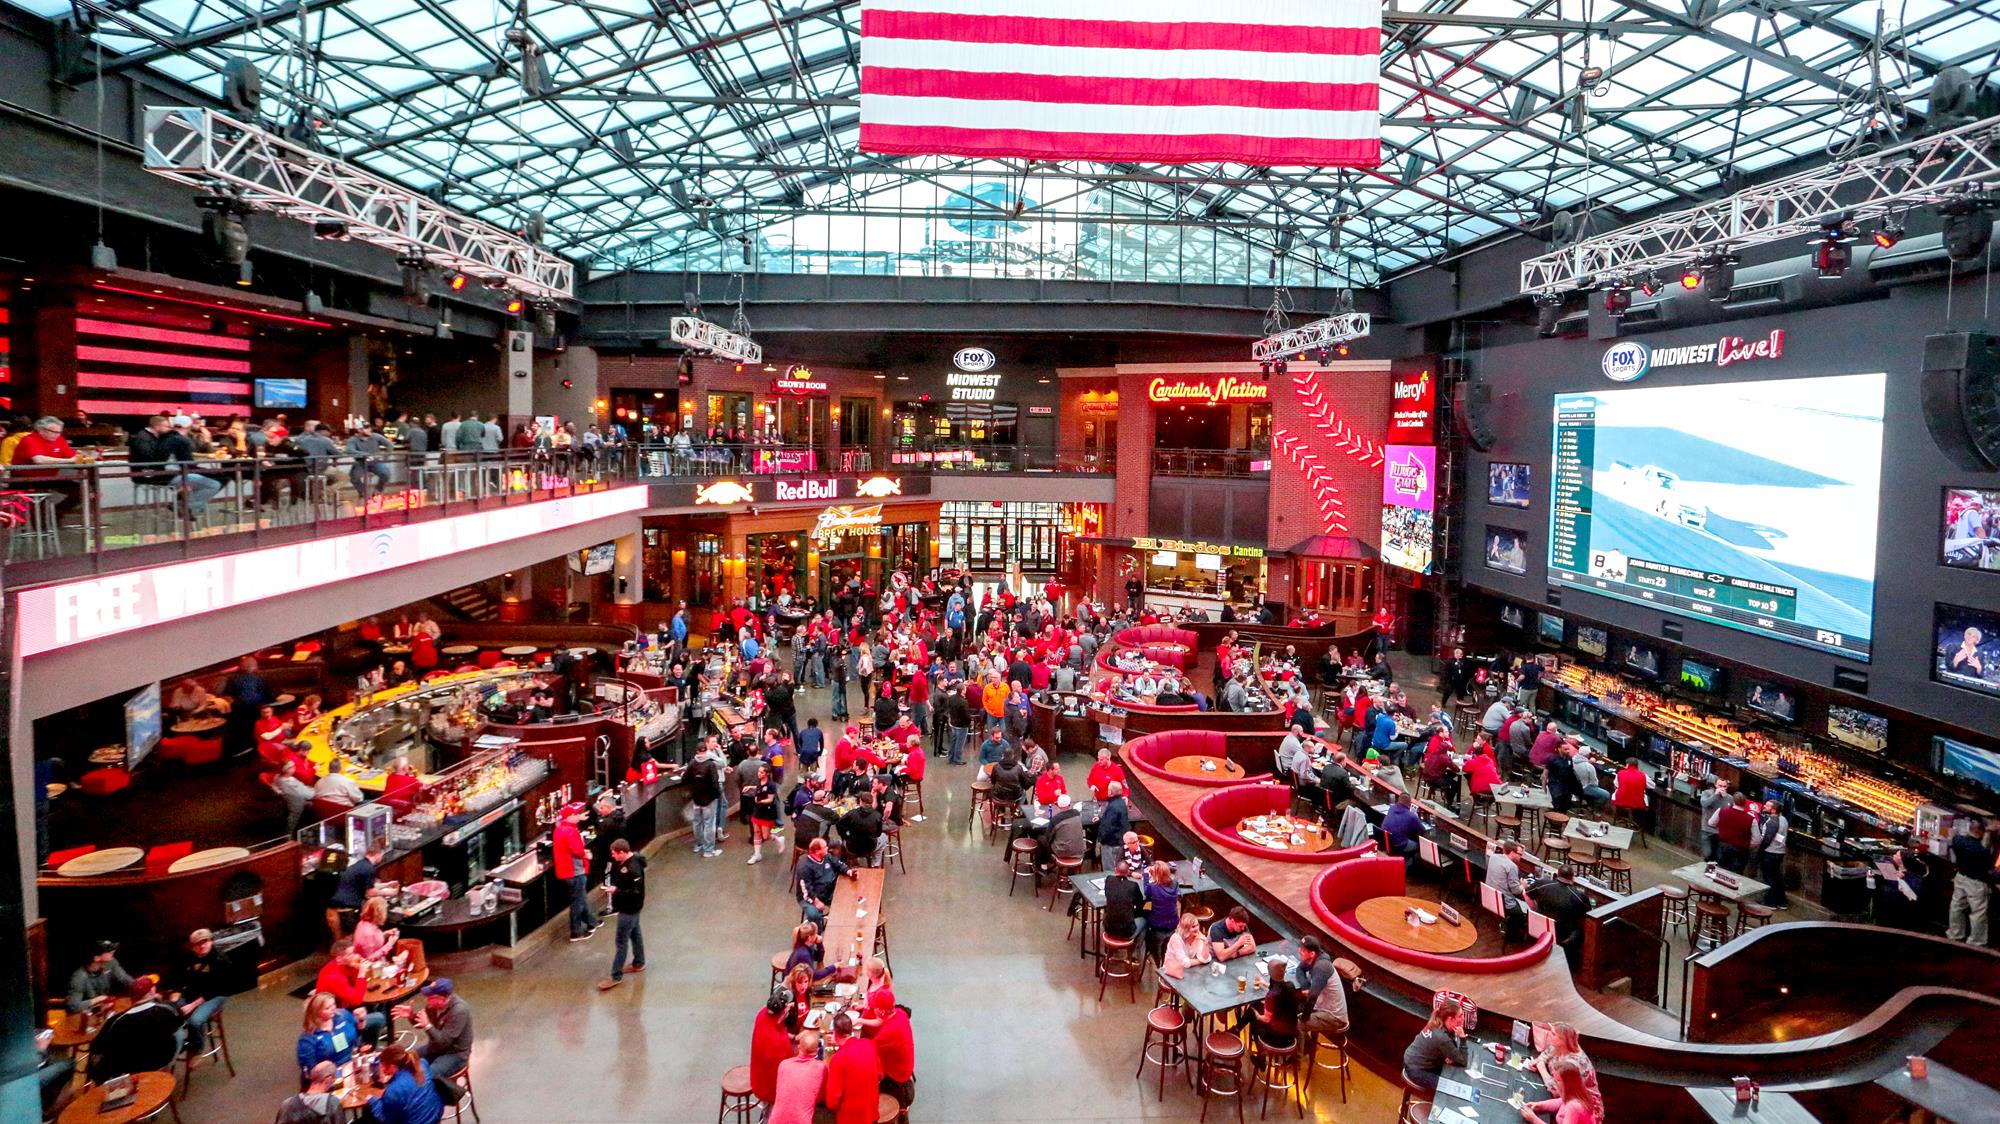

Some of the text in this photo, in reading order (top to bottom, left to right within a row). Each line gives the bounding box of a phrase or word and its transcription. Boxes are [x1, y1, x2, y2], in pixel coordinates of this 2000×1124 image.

[1650, 329, 1785, 367] MIDWEST Live!
[964, 352, 985, 362] FOX
[1612, 350, 1635, 366] FOX
[1611, 365, 1636, 373] SPORTS
[777, 380, 827, 390] CROWN ROOM
[946, 374, 1001, 386] MIDWEST
[952, 388, 995, 400] STUDIO
[1149, 377, 1267, 402] Cardinals Nation
[1394, 381, 1421, 401] Mercy
[1391, 462, 1419, 477] ILLINOIS
[776, 479, 837, 500] Red Bull
[1396, 477, 1417, 489] STATE
[818, 525, 881, 539] BREW HOUSE
[1132, 537, 1264, 557] El Birdos Cantina
[1594, 555, 1605, 567] 8
[1629, 559, 1704, 579] JOHN HUNTER NEMECHEK
[1638, 576, 1666, 587] STARTS 23
[1693, 587, 1716, 598] WINS 2
[1774, 586, 1794, 596] TRACKS
[55, 573, 142, 644] FREE
[1748, 599, 1760, 608] TOP
[1769, 600, 1778, 611] 9
[1816, 630, 1842, 645] FS1
